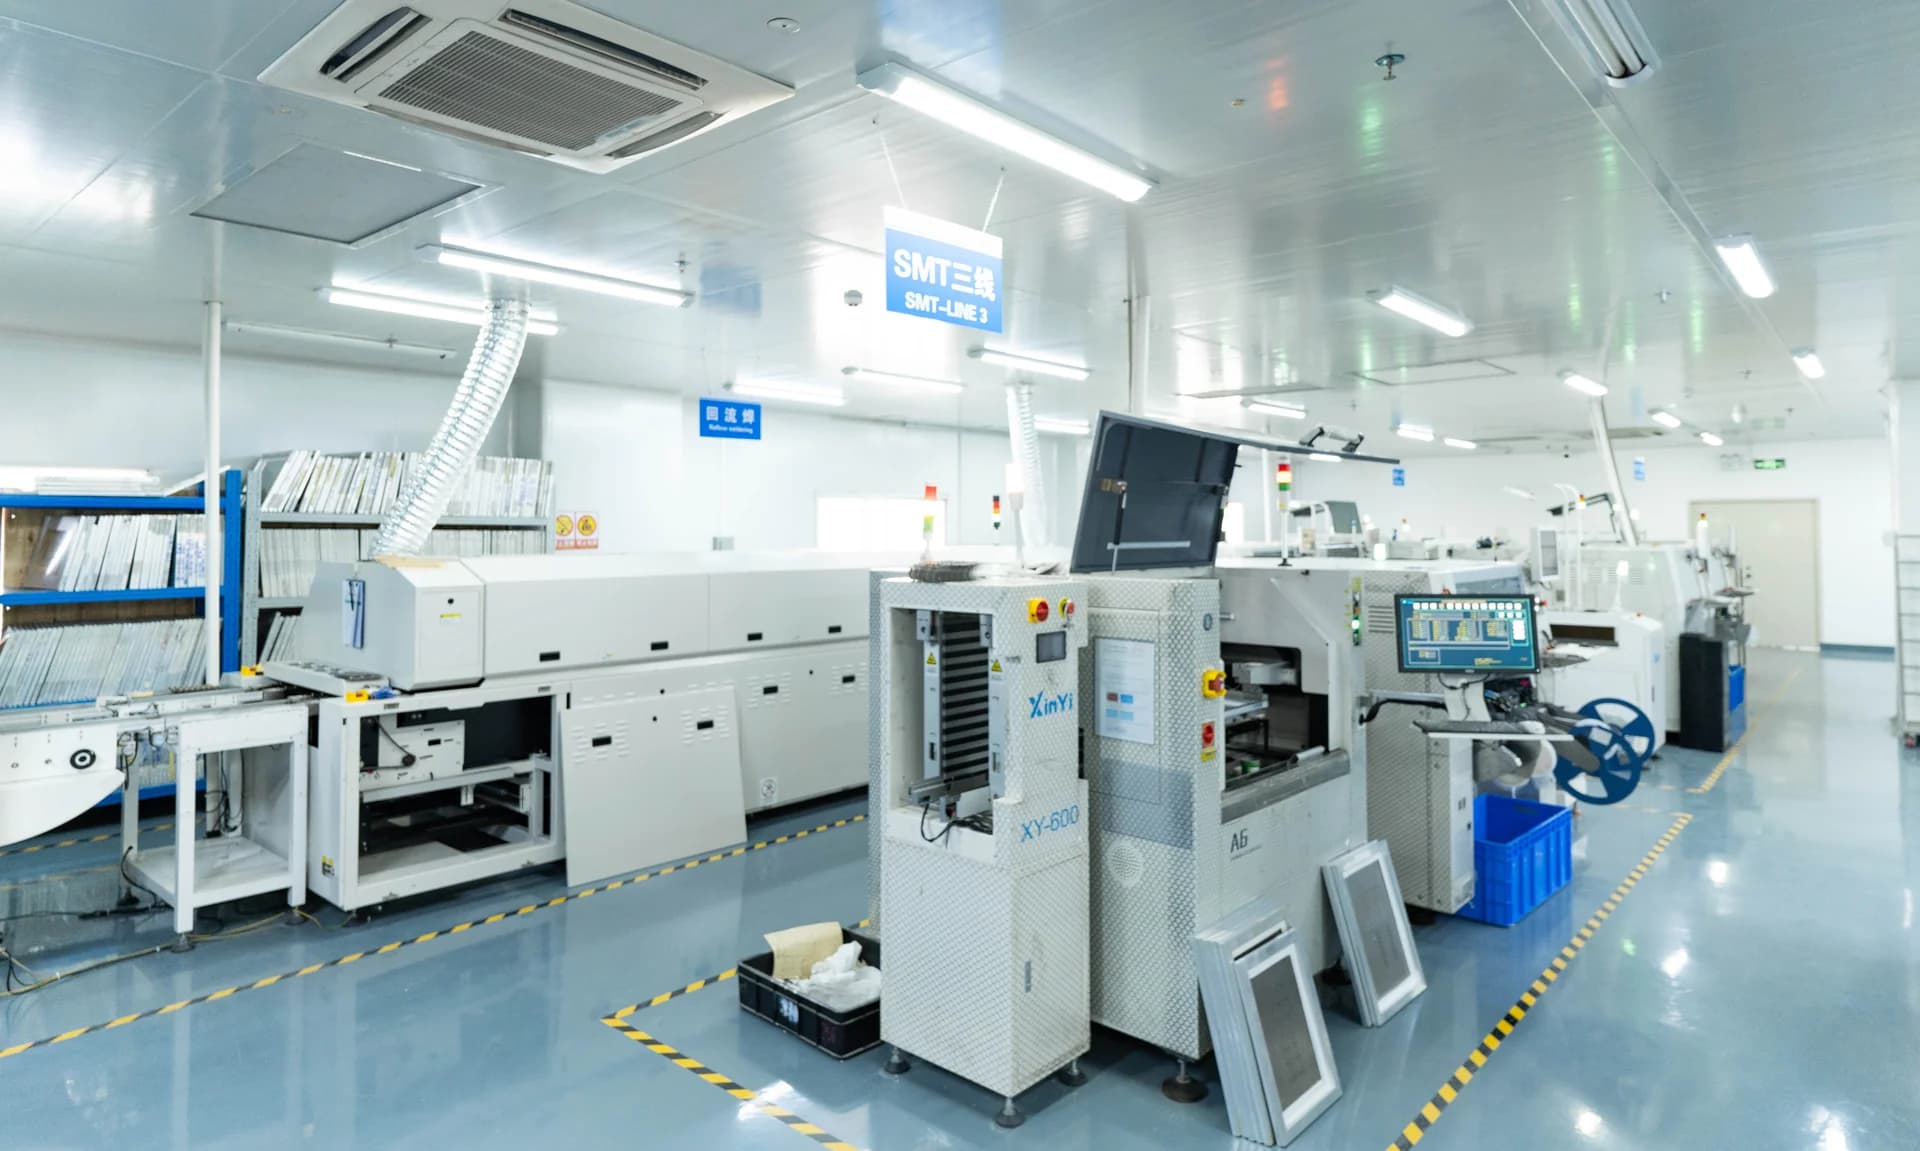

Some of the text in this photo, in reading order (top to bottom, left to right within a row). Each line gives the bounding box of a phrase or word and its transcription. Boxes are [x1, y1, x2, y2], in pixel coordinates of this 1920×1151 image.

[893, 248, 996, 302] SMT三线
[904, 291, 989, 324] SMT-LINE 3
[1028, 690, 1073, 719] XinYi
[1020, 804, 1080, 843] XY-600
